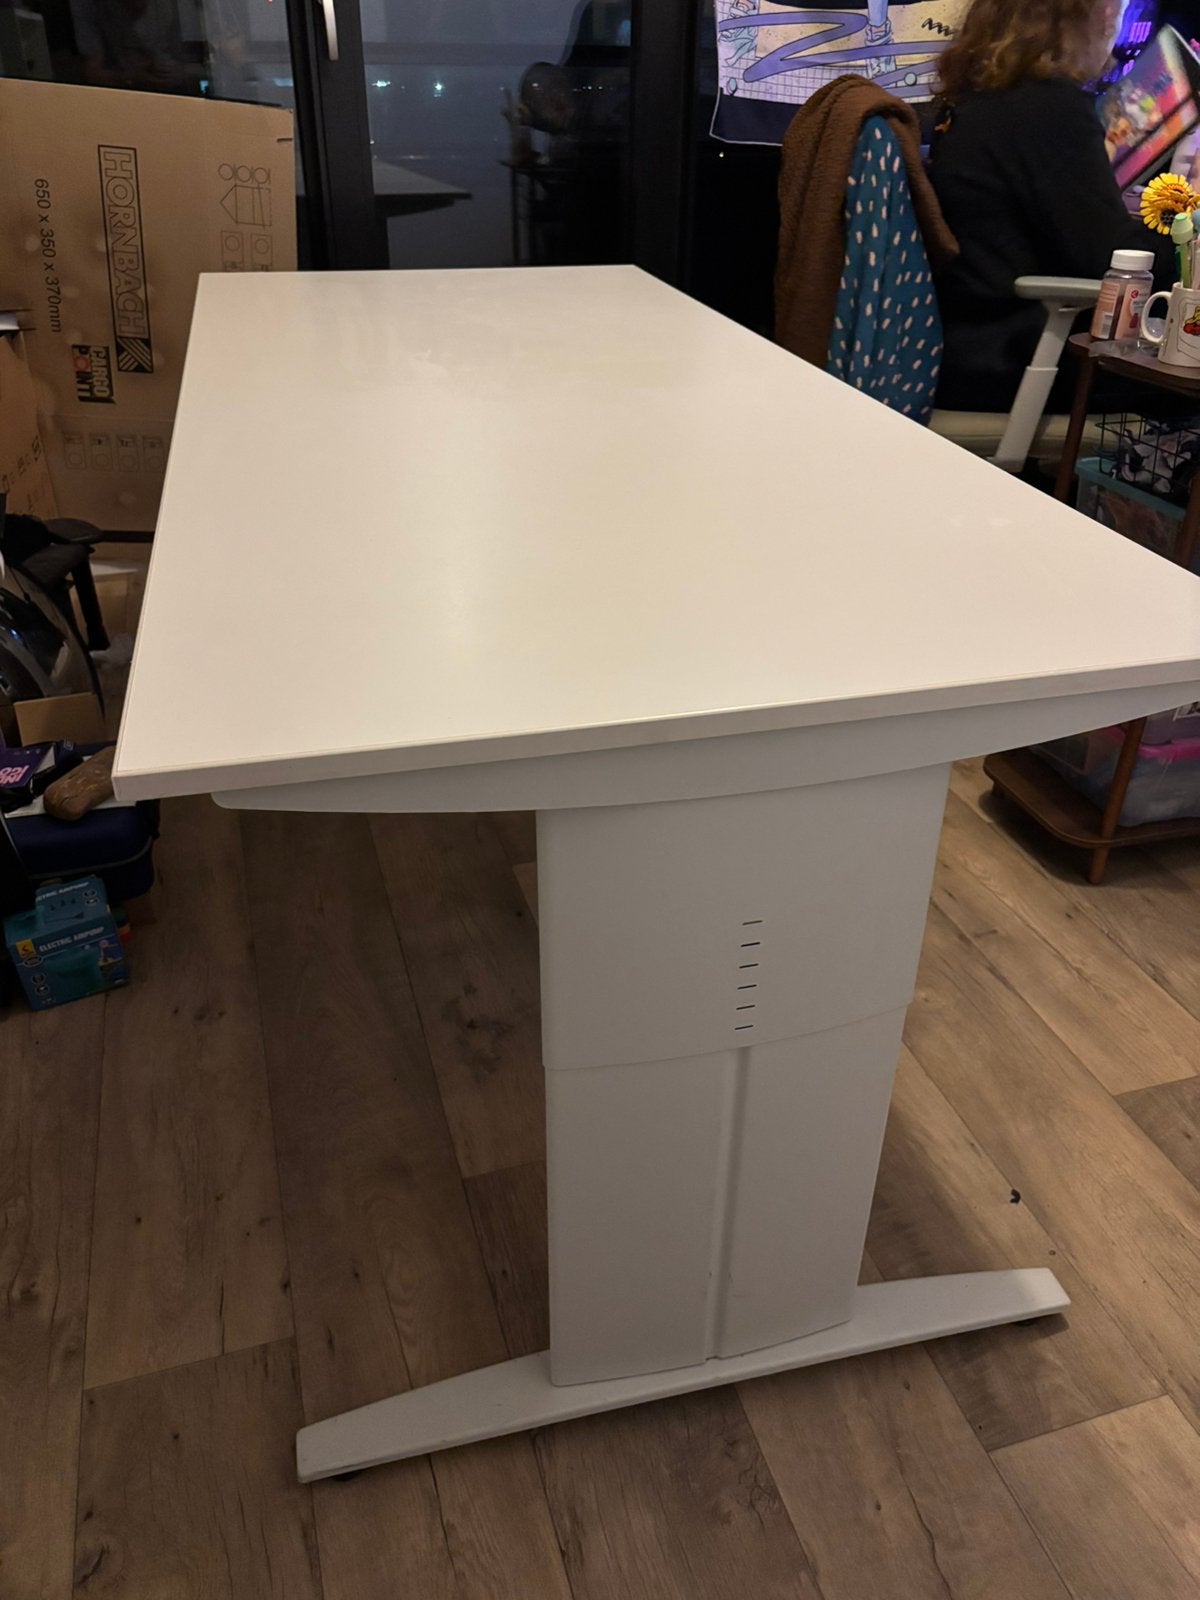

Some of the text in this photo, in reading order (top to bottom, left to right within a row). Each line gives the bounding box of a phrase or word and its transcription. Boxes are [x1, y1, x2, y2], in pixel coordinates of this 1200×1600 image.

[34, 178, 61, 332] 650 x 350 x 370mm
[103, 150, 147, 338] HORNBACH
[90, 345, 110, 397] CARGO
[39, 936, 73, 952] ELECTRIC
